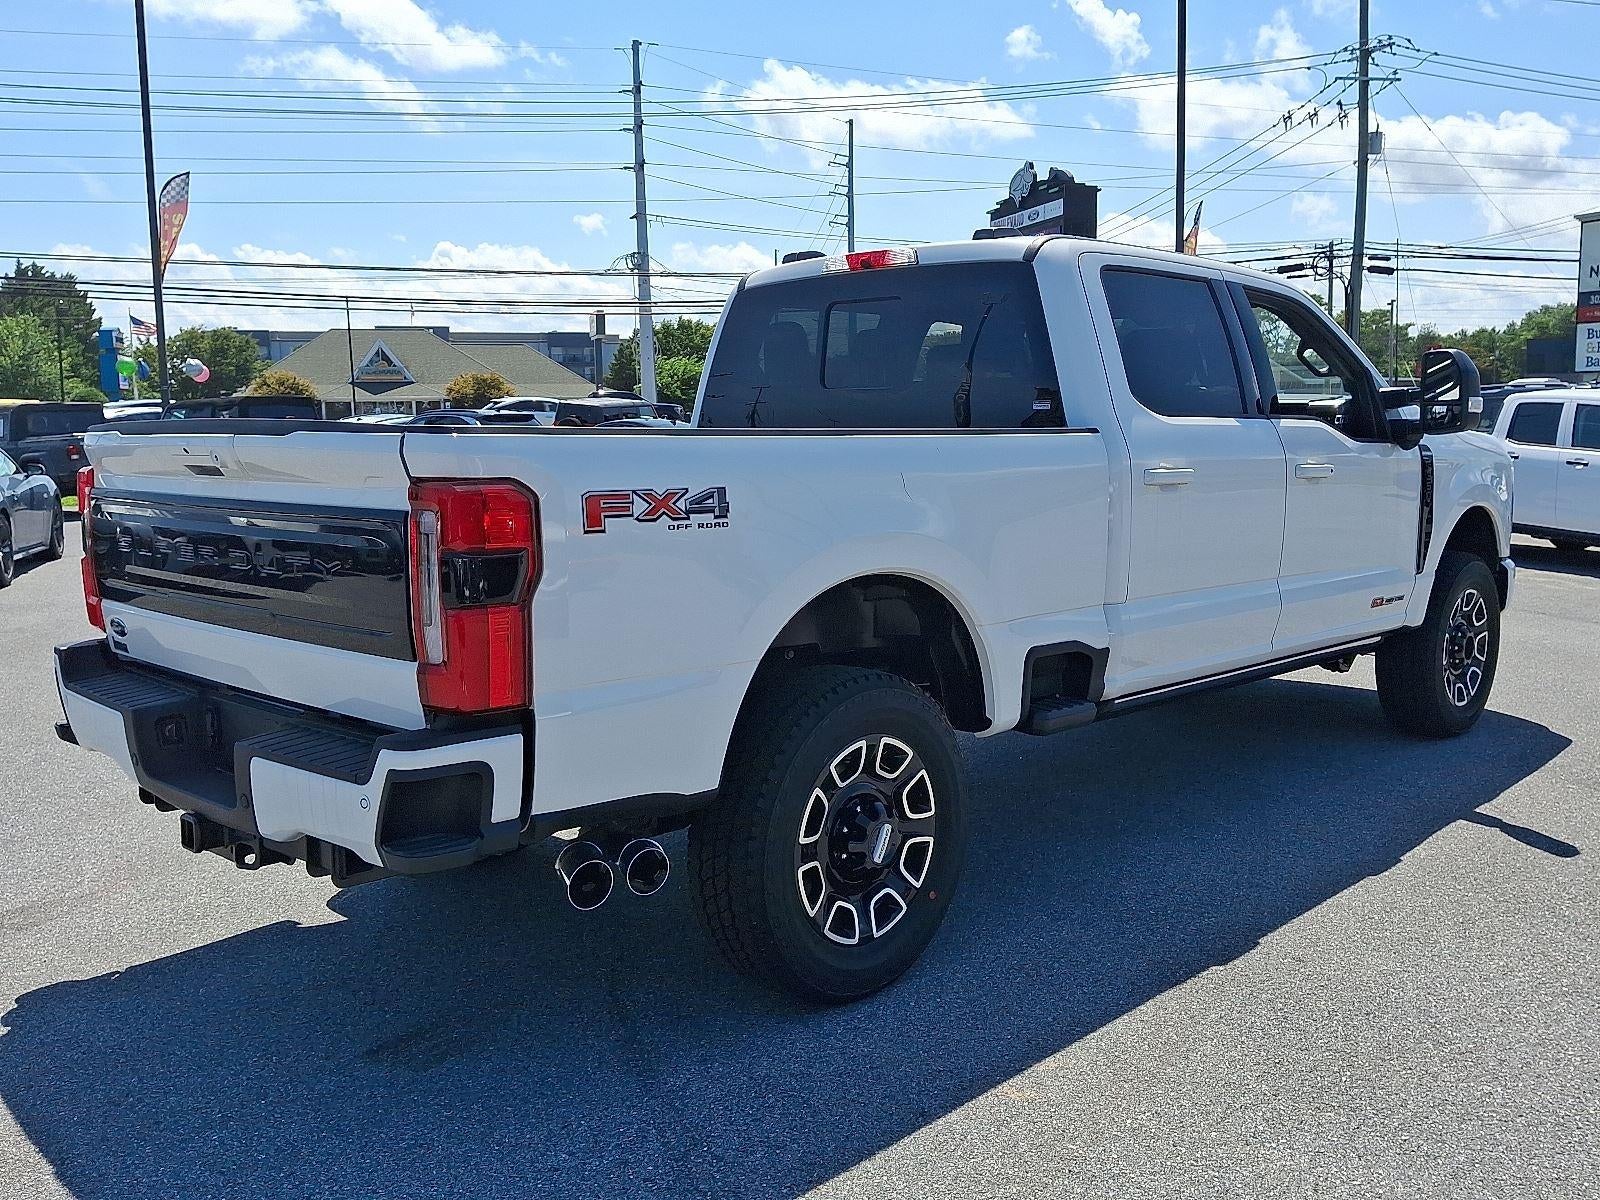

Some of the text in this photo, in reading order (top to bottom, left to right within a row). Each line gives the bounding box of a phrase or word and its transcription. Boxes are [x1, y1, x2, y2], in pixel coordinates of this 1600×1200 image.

[1590, 296, 1600, 305] 30
[581, 486, 730, 534] FX4
[667, 521, 730, 531] OFF ROAD
[228, 548, 342, 580] DUTY
